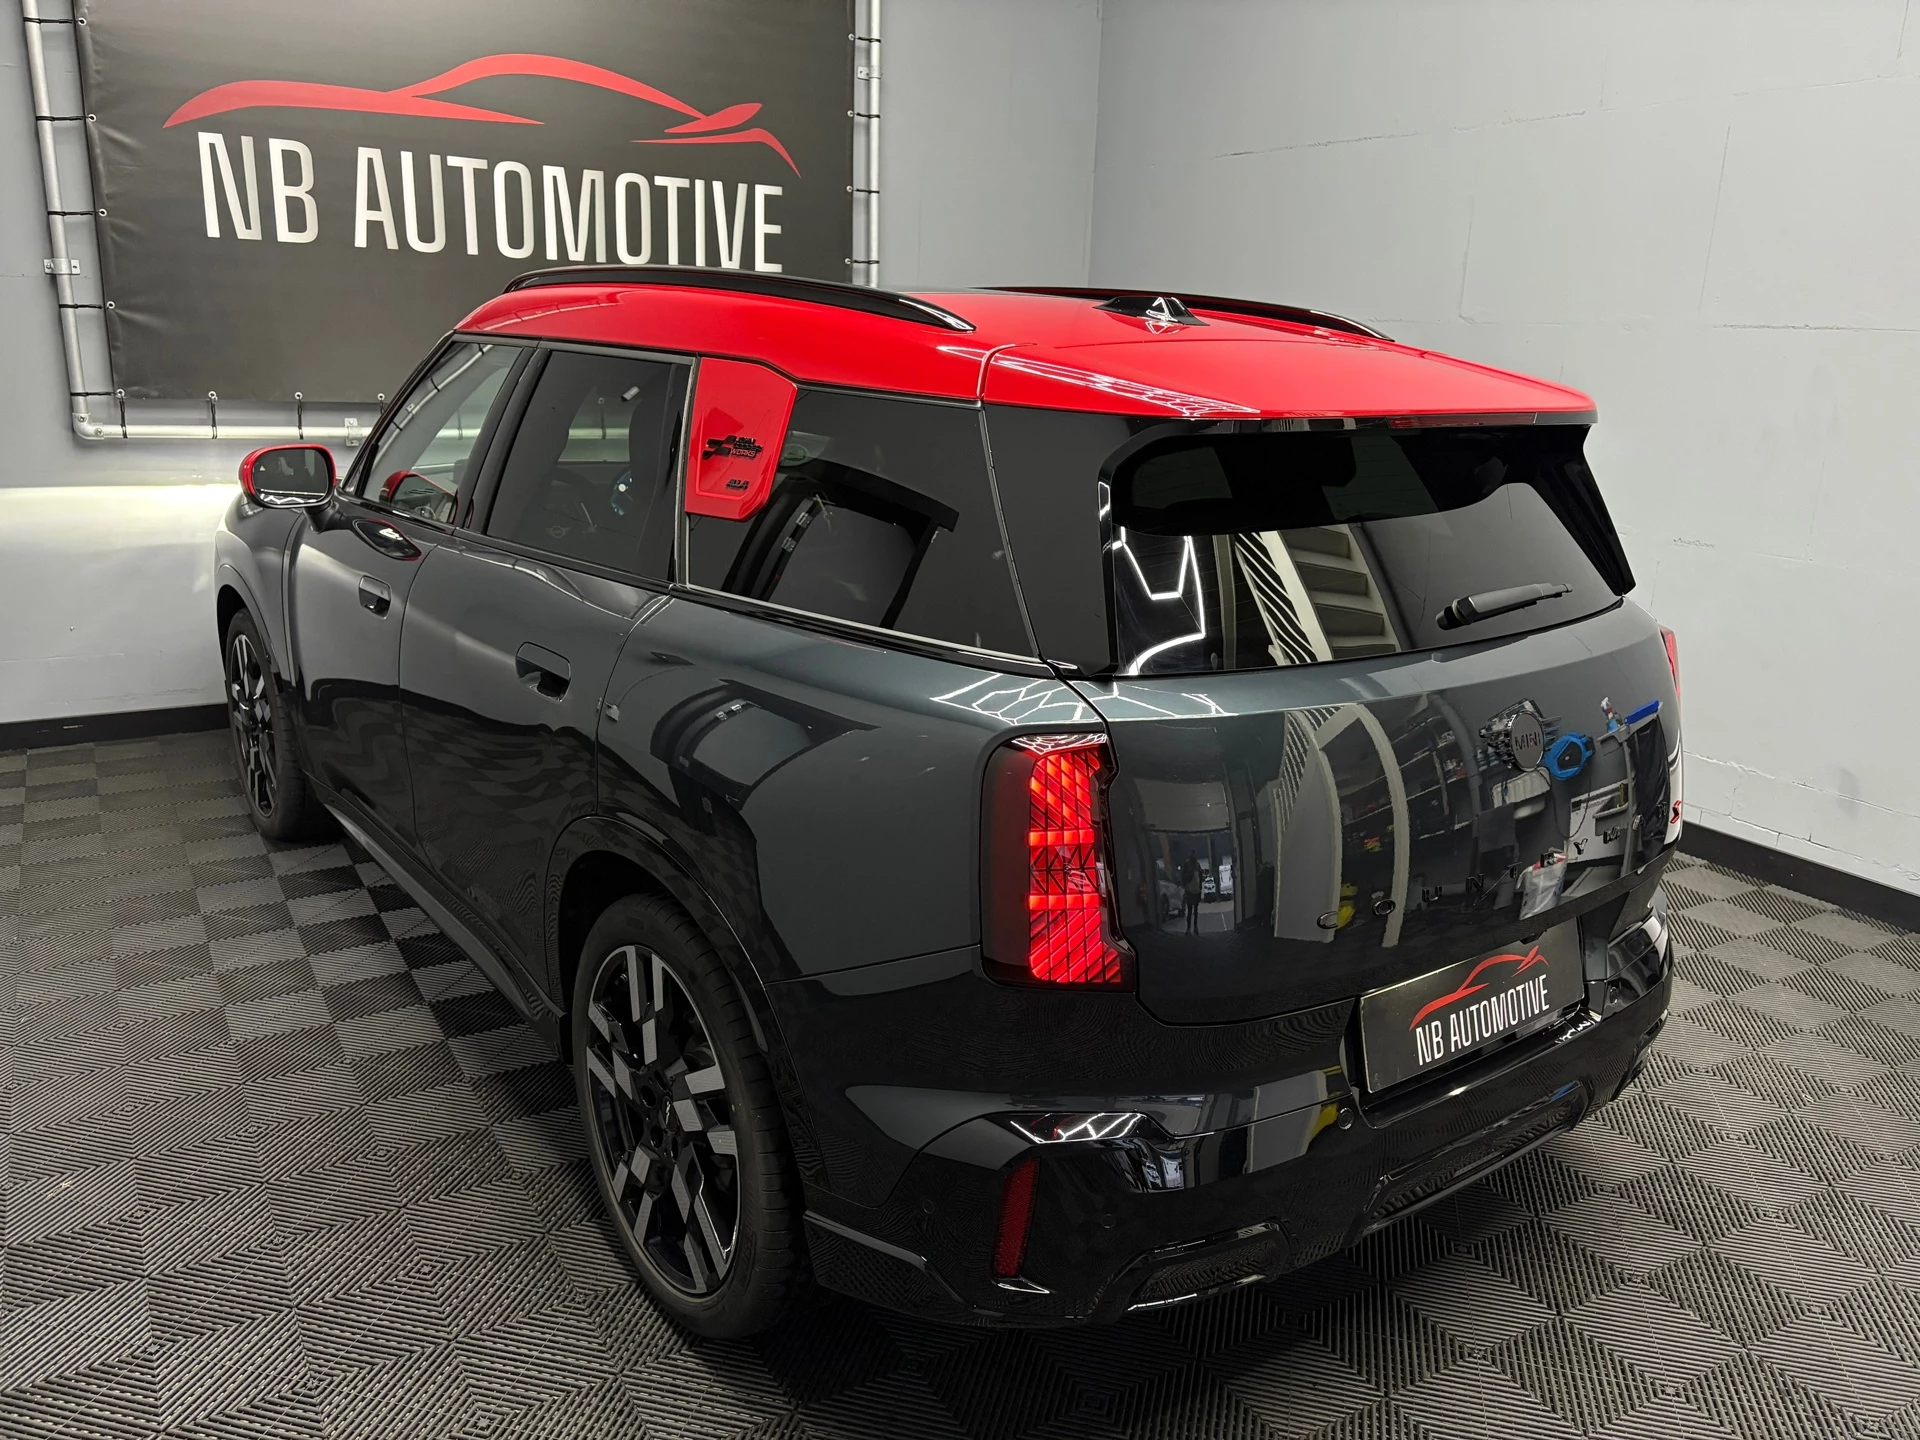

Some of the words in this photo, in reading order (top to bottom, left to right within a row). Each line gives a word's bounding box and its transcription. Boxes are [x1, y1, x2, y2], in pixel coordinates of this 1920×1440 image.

[198, 131, 319, 244] NB
[354, 146, 783, 273] AUTOMOTIVE
[730, 446, 757, 459] WORKS
[1514, 731, 1542, 751] MINI
[1415, 1020, 1444, 1066] NB
[1449, 973, 1550, 1053] AUTOMOTIVE
